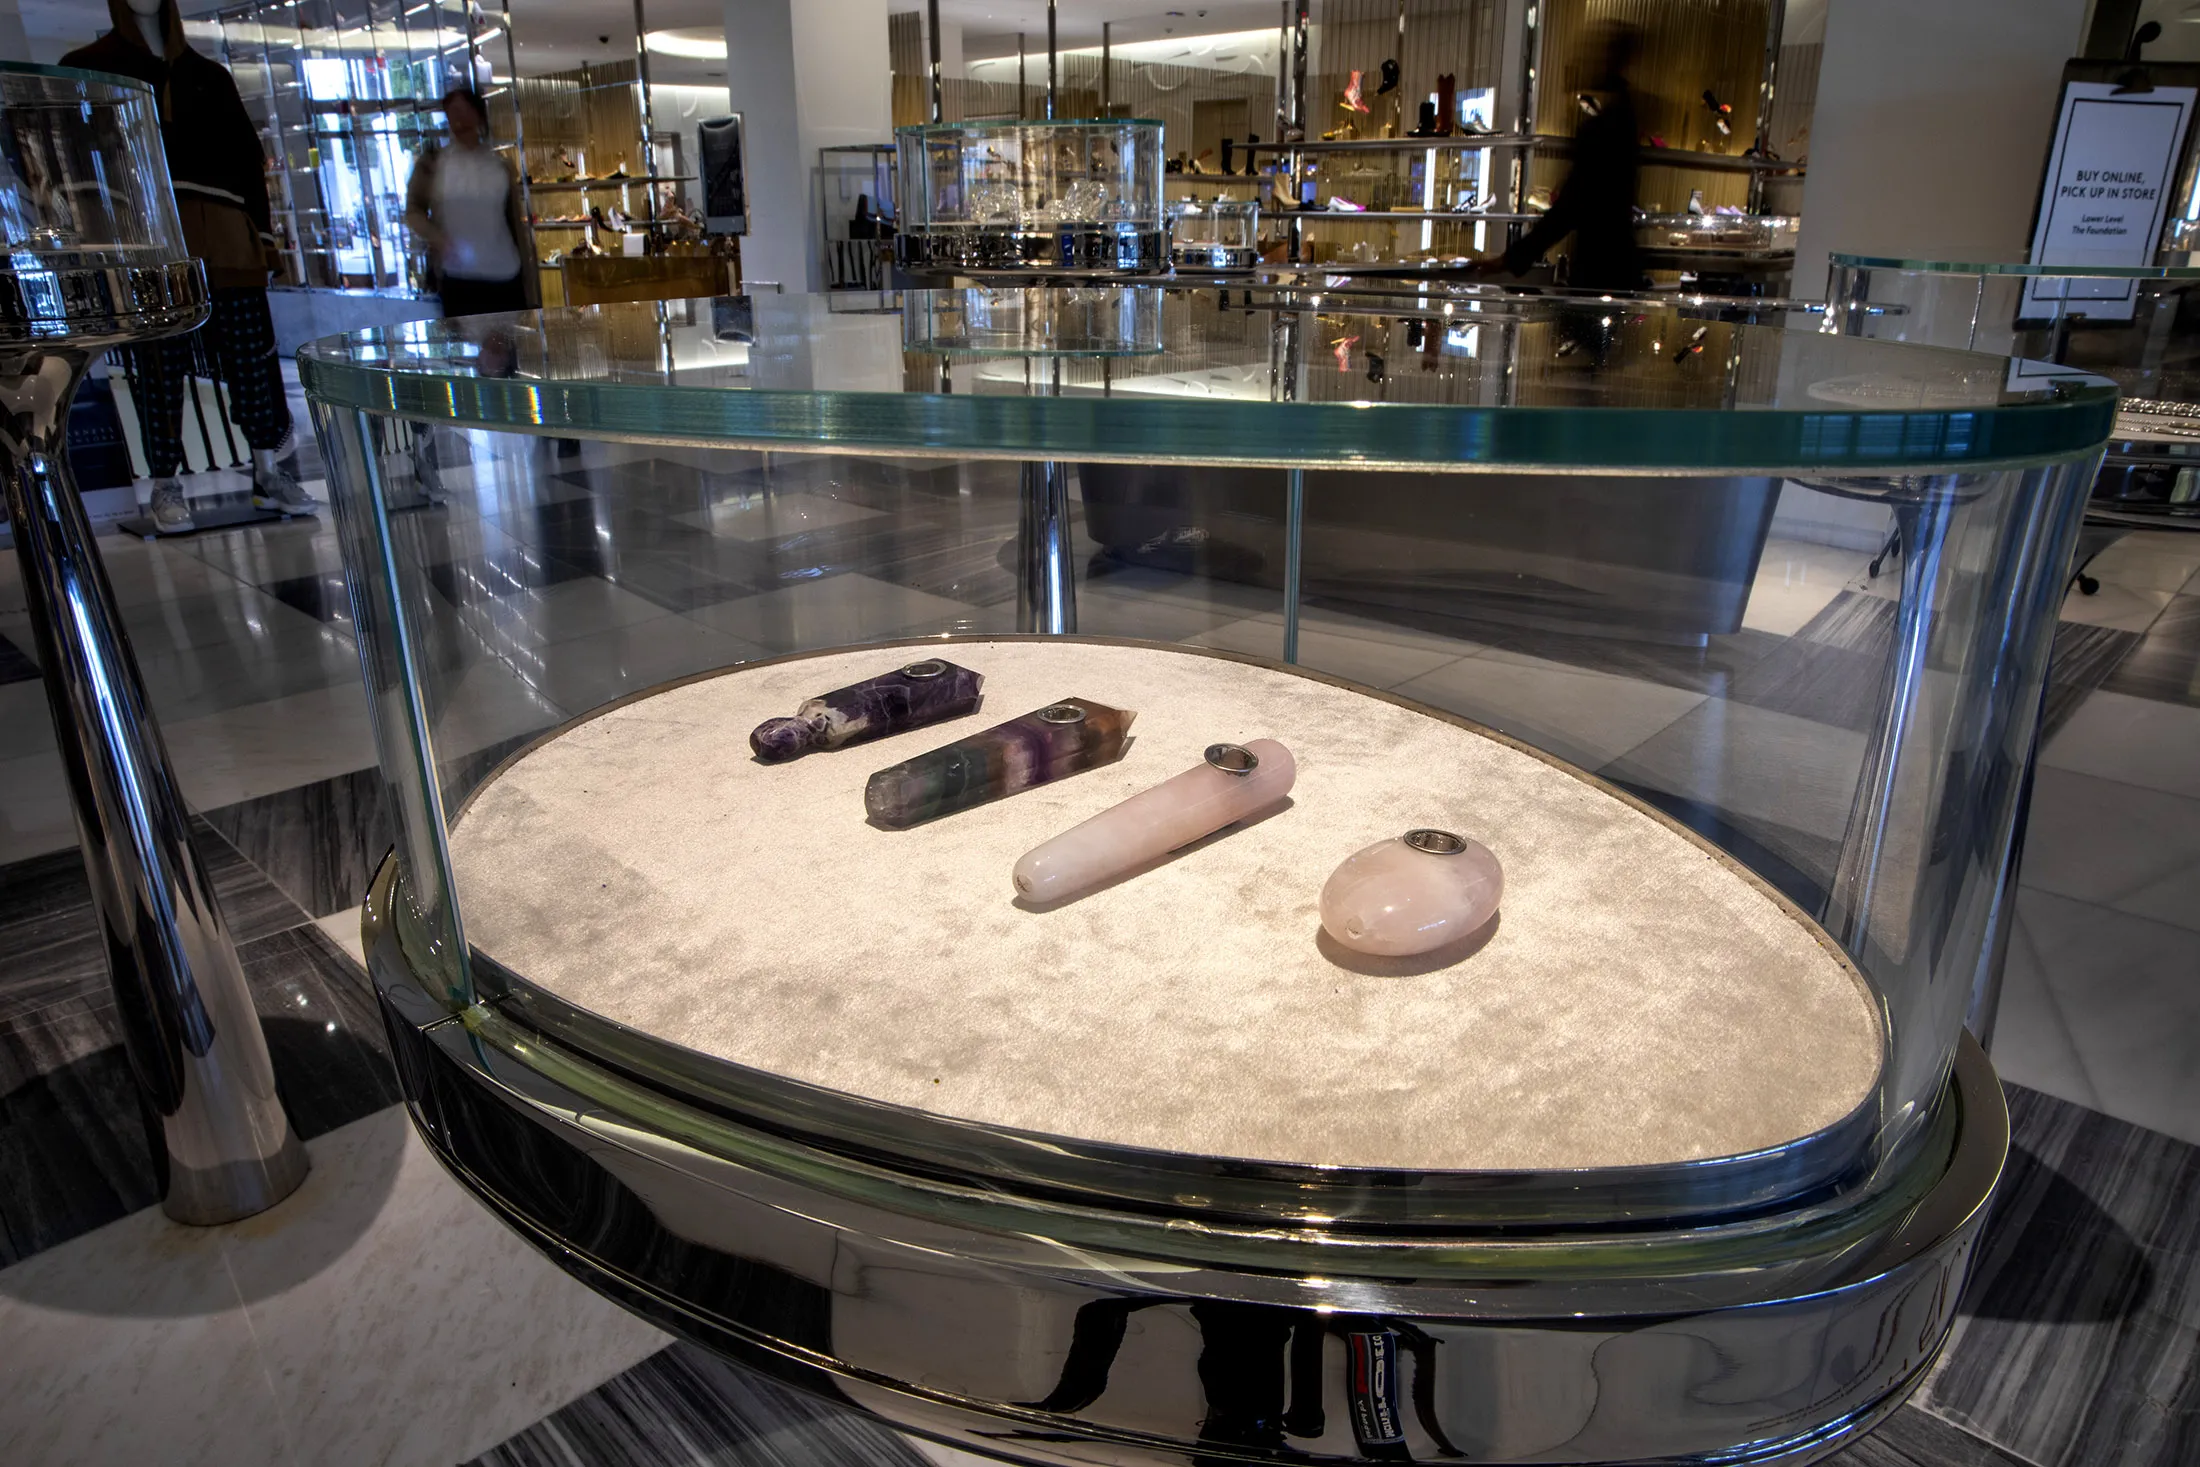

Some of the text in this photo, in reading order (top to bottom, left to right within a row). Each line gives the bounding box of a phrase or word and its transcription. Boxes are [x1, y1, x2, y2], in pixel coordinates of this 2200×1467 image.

[2076, 170, 2145, 185] BUY ONLINE,
[2060, 186, 2156, 200] PICK UP IN STORE
[2081, 214, 2125, 223] Lower Level
[2072, 225, 2128, 235] The Foundation
